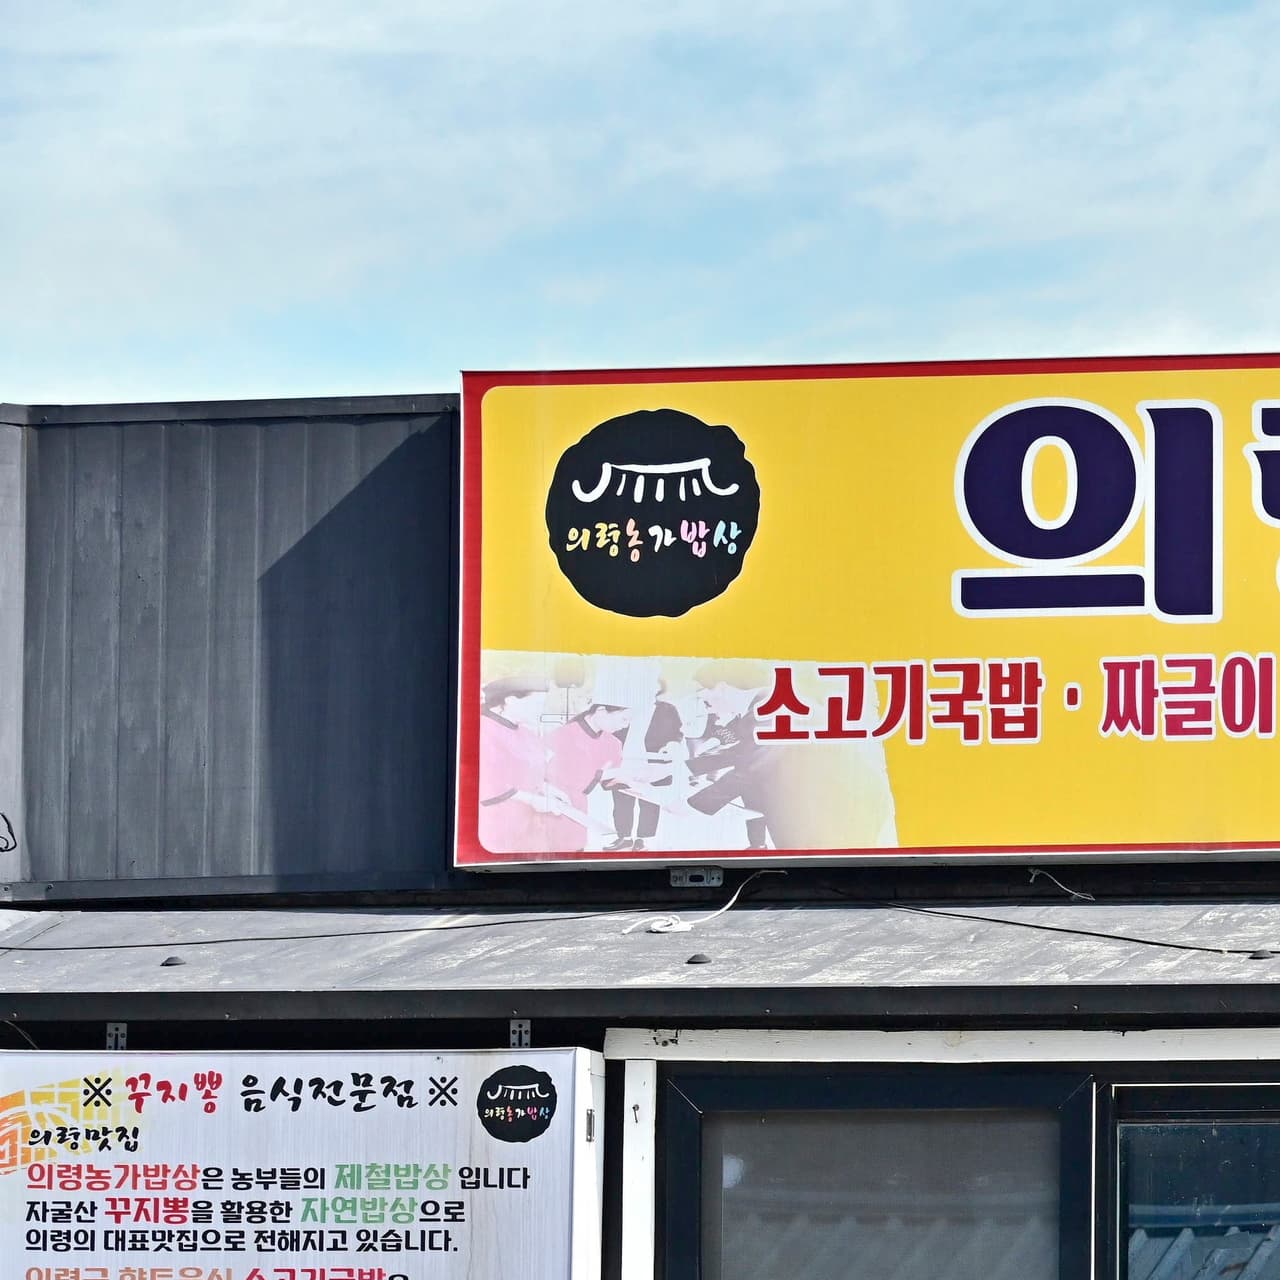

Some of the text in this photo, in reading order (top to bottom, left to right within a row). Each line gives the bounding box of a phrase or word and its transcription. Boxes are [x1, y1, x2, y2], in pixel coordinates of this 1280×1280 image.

[566, 518, 742, 562] 의령농가밥상
[755, 658, 1042, 744] 소고기국밥
[1100, 653, 1275, 739] 짜글이
[126, 1070, 418, 1113] 꾸지뽕 음식전문점
[29, 1126, 139, 1152] 의령맛집
[27, 1163, 530, 1191] 의령농가밥상은 농부들의 제철밥상 입니다
[25, 1197, 465, 1224] 자굴산 꾸지뽕을 활용한 자연밥상으로
[25, 1229, 458, 1252] 의령의 대표맛집으로 전해지고 있습니다.
